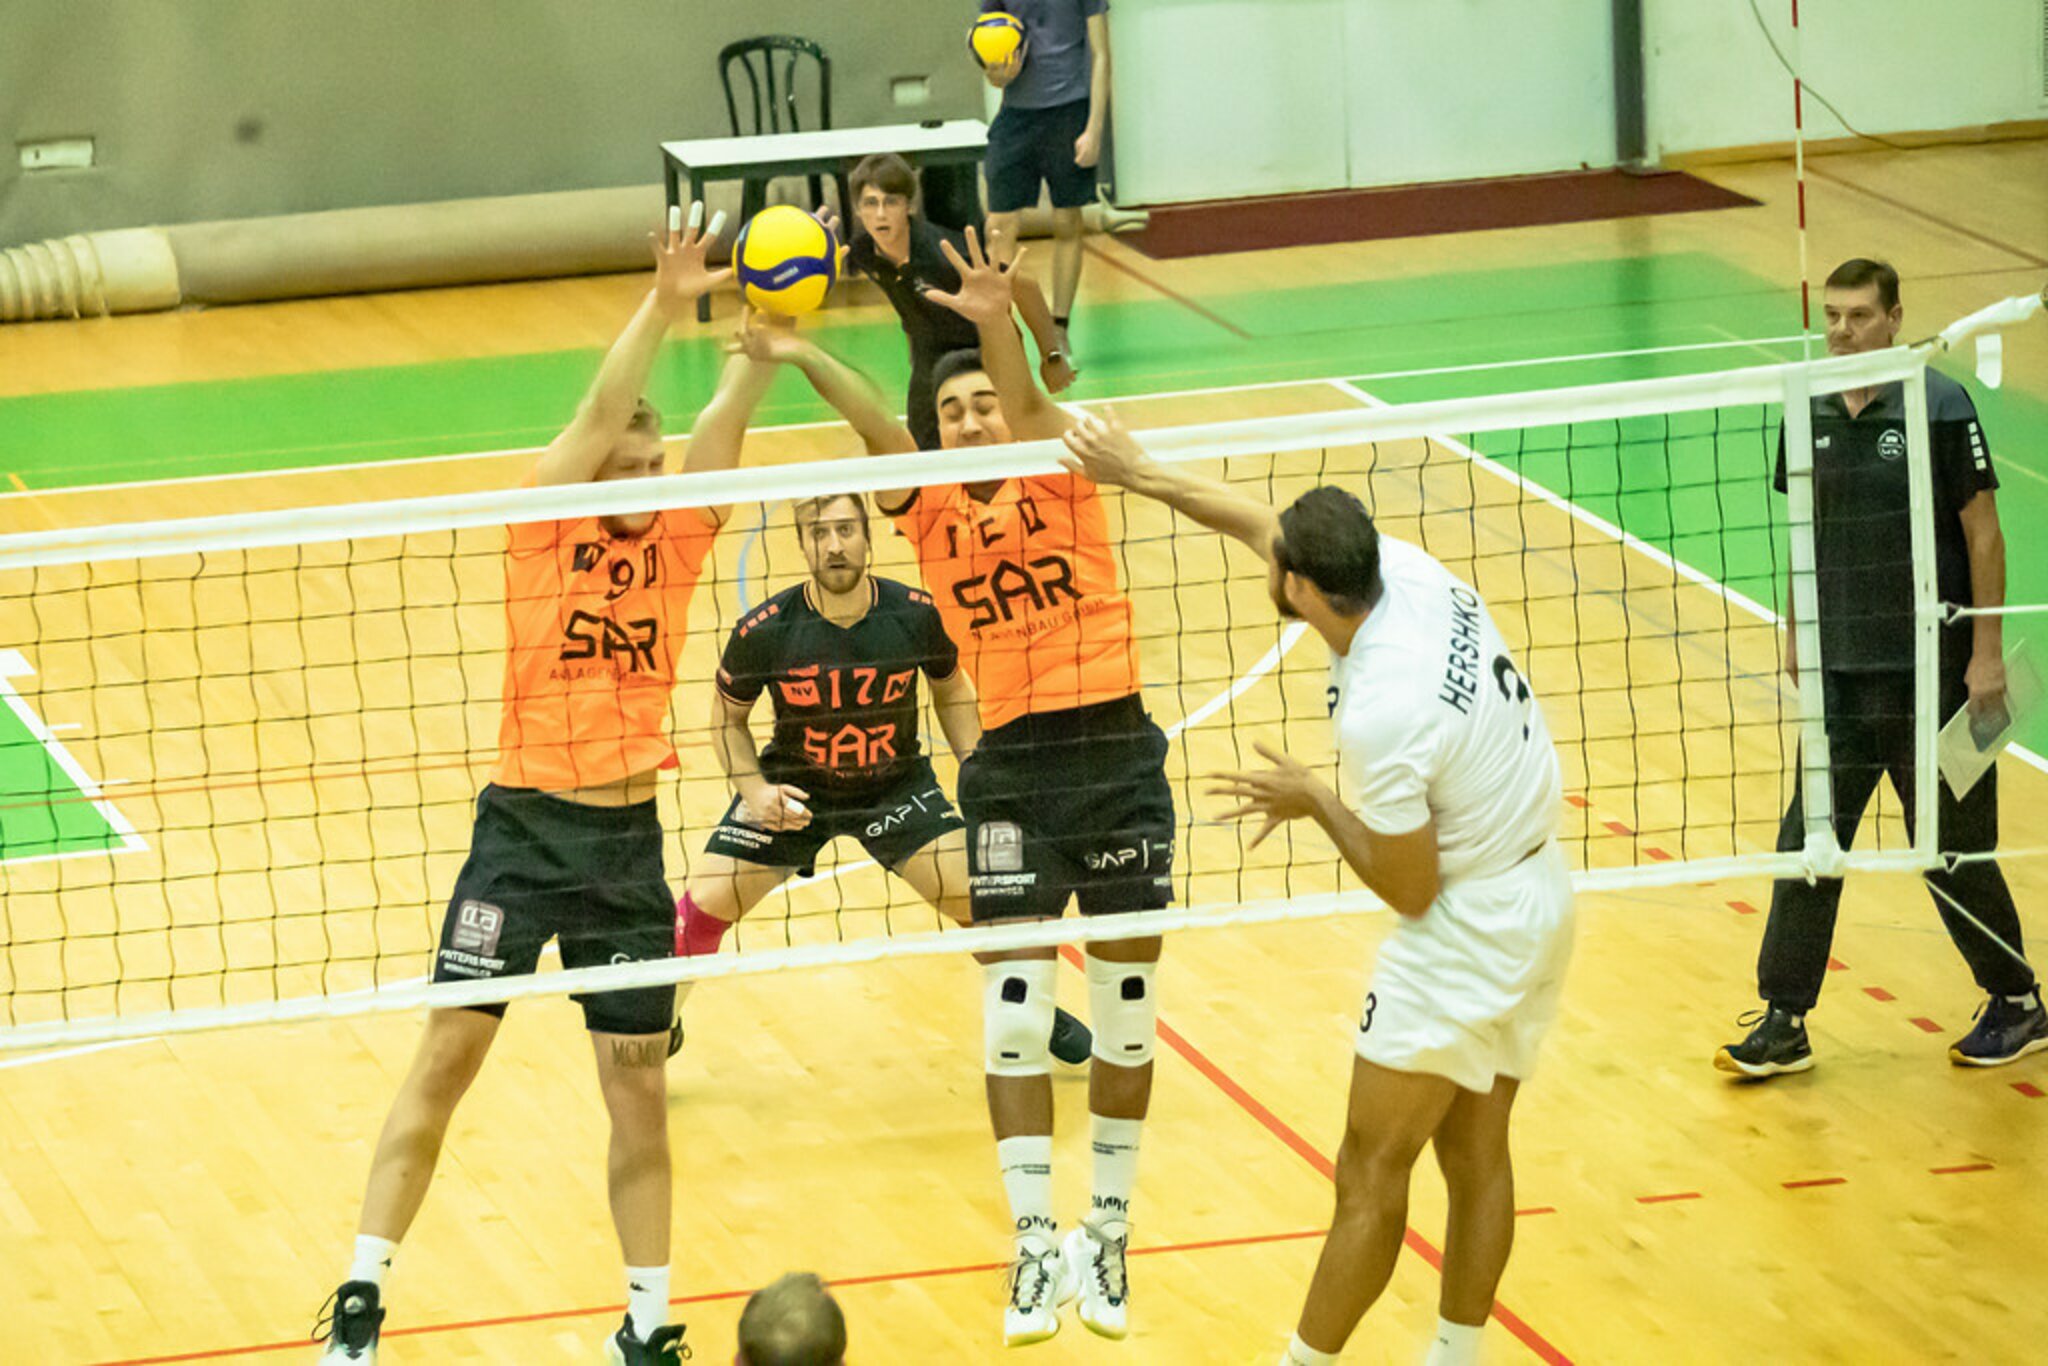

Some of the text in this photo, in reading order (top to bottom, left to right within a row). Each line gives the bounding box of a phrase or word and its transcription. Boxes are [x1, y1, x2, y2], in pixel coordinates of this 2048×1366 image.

[952, 555, 1083, 630] SAR
[559, 609, 657, 673] SAR
[1438, 586, 1480, 716] HERSHKO
[827, 667, 878, 709] 17
[803, 723, 896, 768] SAR
[1360, 992, 1377, 1033] 3
